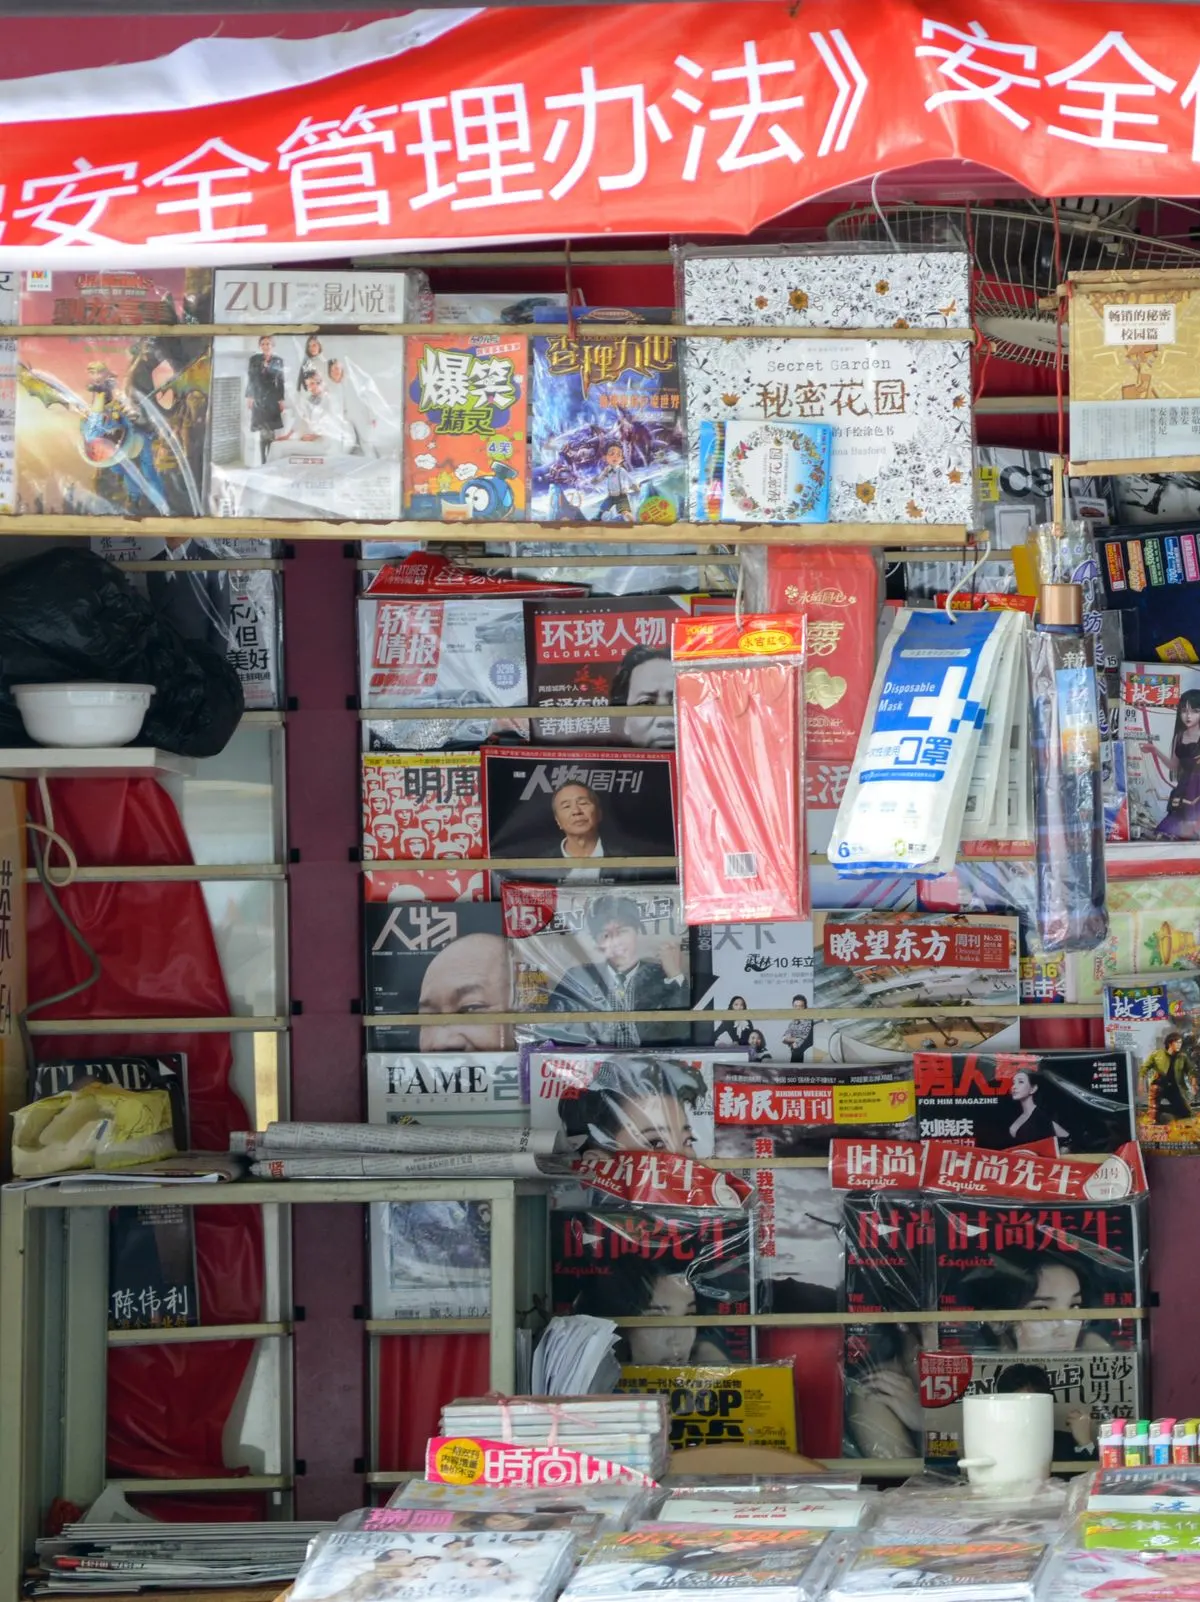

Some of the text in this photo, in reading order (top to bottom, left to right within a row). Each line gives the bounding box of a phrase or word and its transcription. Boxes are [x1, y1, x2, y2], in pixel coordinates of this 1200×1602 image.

[0, 28, 868, 248] 安全管理办法》
[223, 281, 291, 312] ZUI
[322, 282, 386, 314] 最小说
[1107, 307, 1172, 323] 畅销的秘密
[1120, 327, 1160, 342] 校园篇
[766, 358, 892, 373] Secret Garden
[418, 346, 516, 411] 爆笑
[750, 378, 908, 420] 秘密花园
[378, 603, 441, 634] 轿车
[235, 626, 257, 648] 但
[540, 615, 668, 649] 环球人物
[226, 649, 270, 670] 美好
[375, 632, 440, 666] 情报
[542, 650, 600, 659] GLOBAL
[1106, 656, 1117, 666] 15
[883, 680, 935, 695] Disposable
[878, 698, 904, 714] Mask
[539, 717, 612, 737] 苦难辉煌
[898, 735, 953, 767] 口罩
[403, 766, 481, 805] 明周
[837, 841, 850, 858] 6
[372, 906, 458, 951] 人物
[830, 932, 981, 964] 瞭望东方 周刊
[774, 957, 789, 968] 10
[1110, 997, 1166, 1020] 故事
[385, 1065, 488, 1095] FAME
[718, 1087, 834, 1122] 新民周刊
[918, 1097, 999, 1106] FOR HIM MAGAZINE
[920, 1118, 974, 1139] 刘晓庆
[846, 1144, 916, 1176] 时尚
[938, 1148, 1082, 1196] 时尚先生
[847, 1174, 899, 1188] Esquire
[937, 1173, 988, 1193] Esquire
[563, 1214, 740, 1262] 时尚先生
[859, 1209, 934, 1250] 时尚
[948, 1209, 1124, 1253] 时尚先生
[847, 1252, 907, 1266] Esquire
[938, 1253, 996, 1267] Esquire
[112, 1284, 189, 1319] 陈伟利
[1089, 1356, 1135, 1380] 芭莎
[1089, 1380, 1134, 1404] 男士
